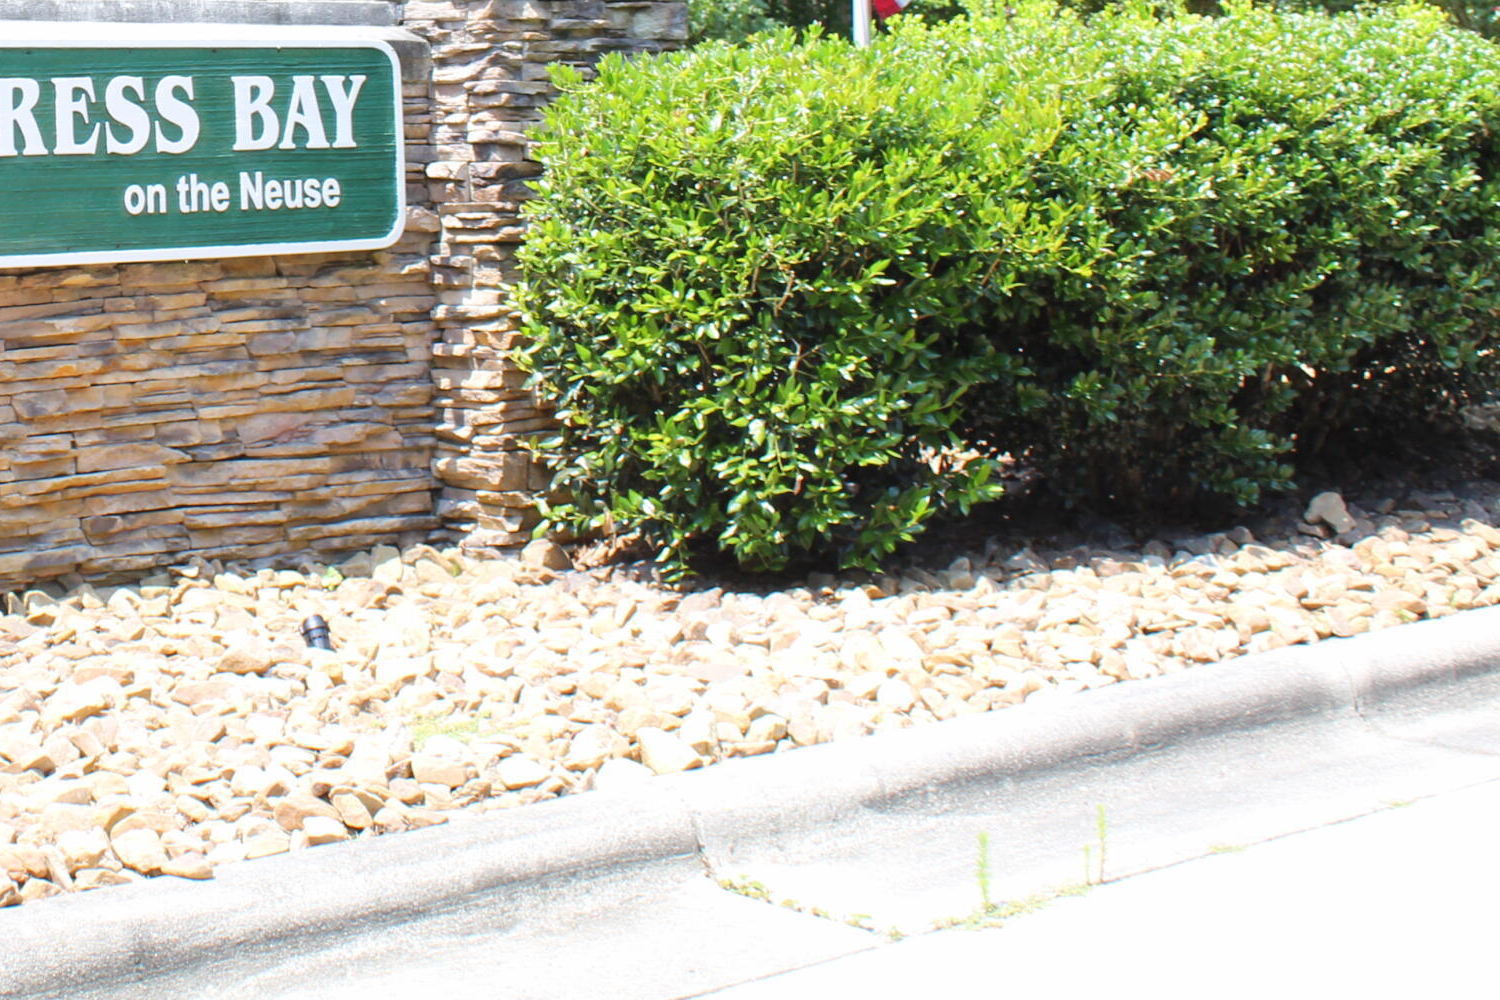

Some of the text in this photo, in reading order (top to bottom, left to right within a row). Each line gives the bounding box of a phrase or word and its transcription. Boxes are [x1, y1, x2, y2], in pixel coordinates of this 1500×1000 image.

[231, 74, 367, 151] BAY
[123, 171, 342, 216] on the Neuse
